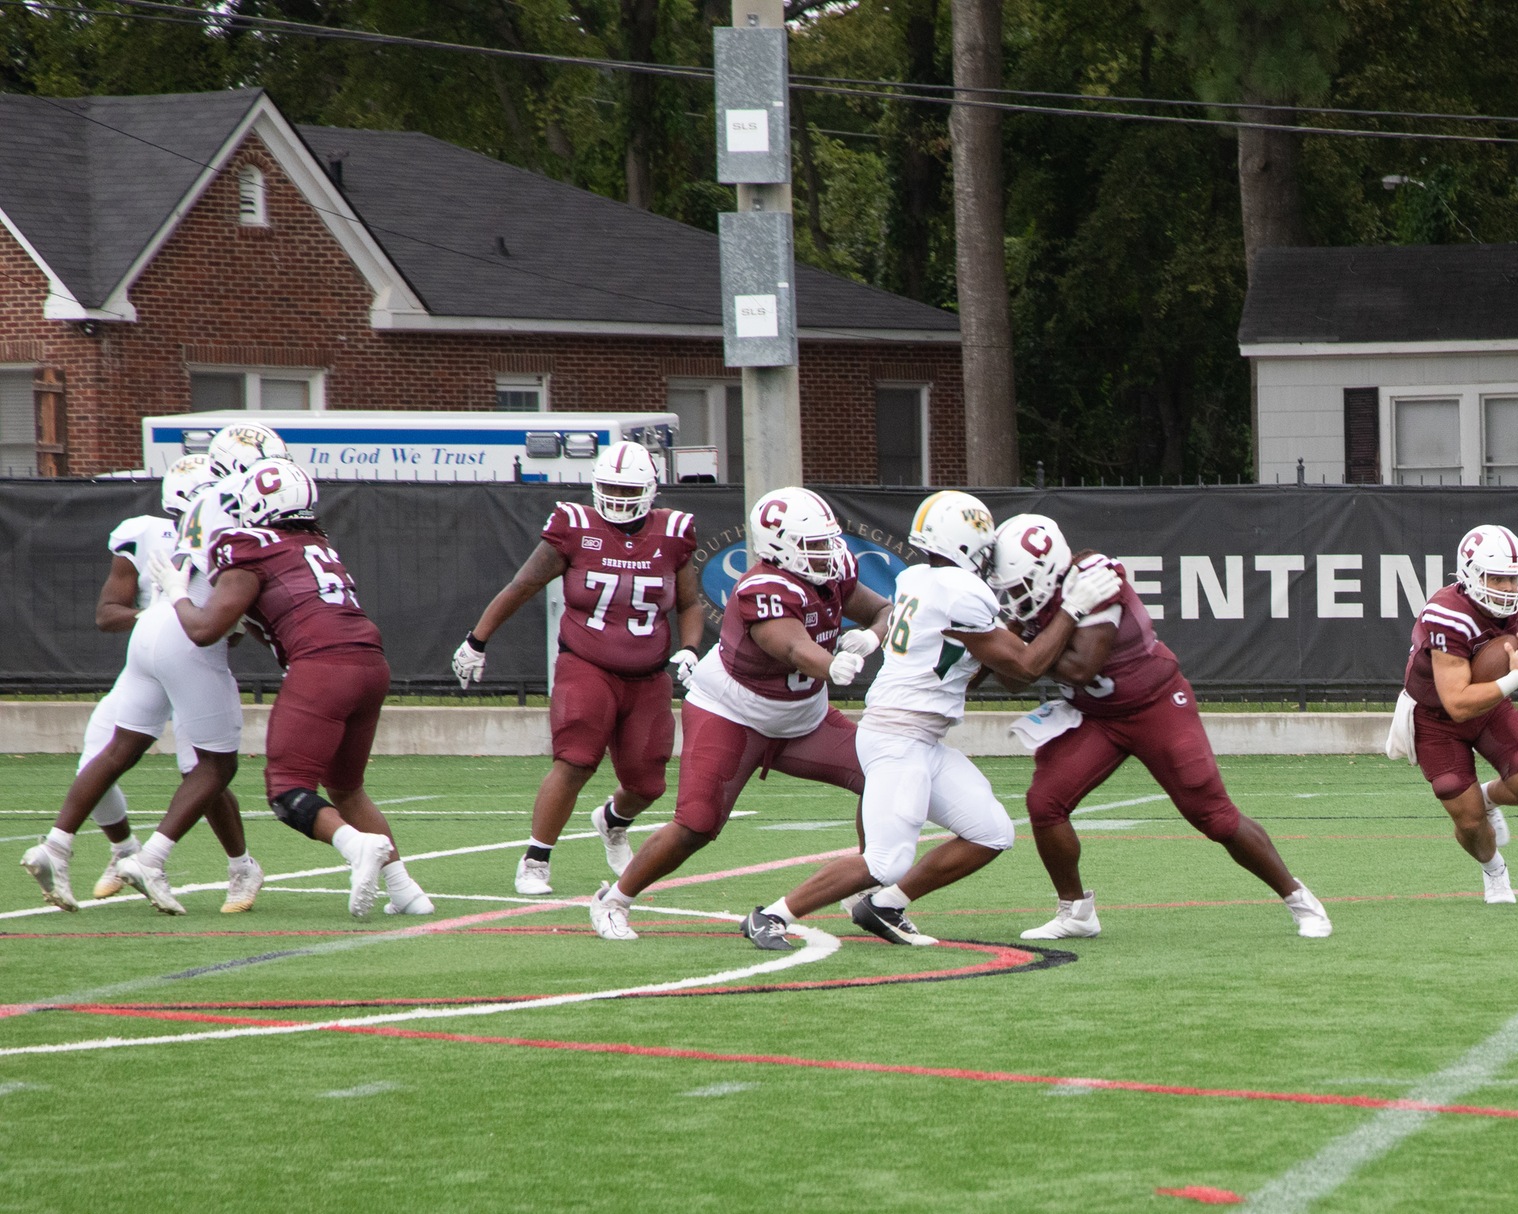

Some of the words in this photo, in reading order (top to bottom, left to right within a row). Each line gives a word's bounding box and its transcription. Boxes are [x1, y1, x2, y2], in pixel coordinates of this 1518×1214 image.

[732, 122, 758, 131] SLS
[741, 308, 767, 316] SLS
[229, 428, 267, 444] WCU
[309, 447, 330, 464] In
[340, 447, 381, 465] God
[391, 447, 422, 464] We
[431, 447, 486, 465] Trust
[255, 467, 282, 495] C
[760, 500, 788, 529] C
[625, 541, 634, 549] C
[1021, 527, 1053, 558] C
[1460, 532, 1484, 560] C
[601, 557, 652, 570] SHREVEPORT
[586, 571, 664, 636] 75
[756, 593, 784, 619] 56
[1430, 631, 1448, 653] 19
[1172, 690, 1188, 708] C
